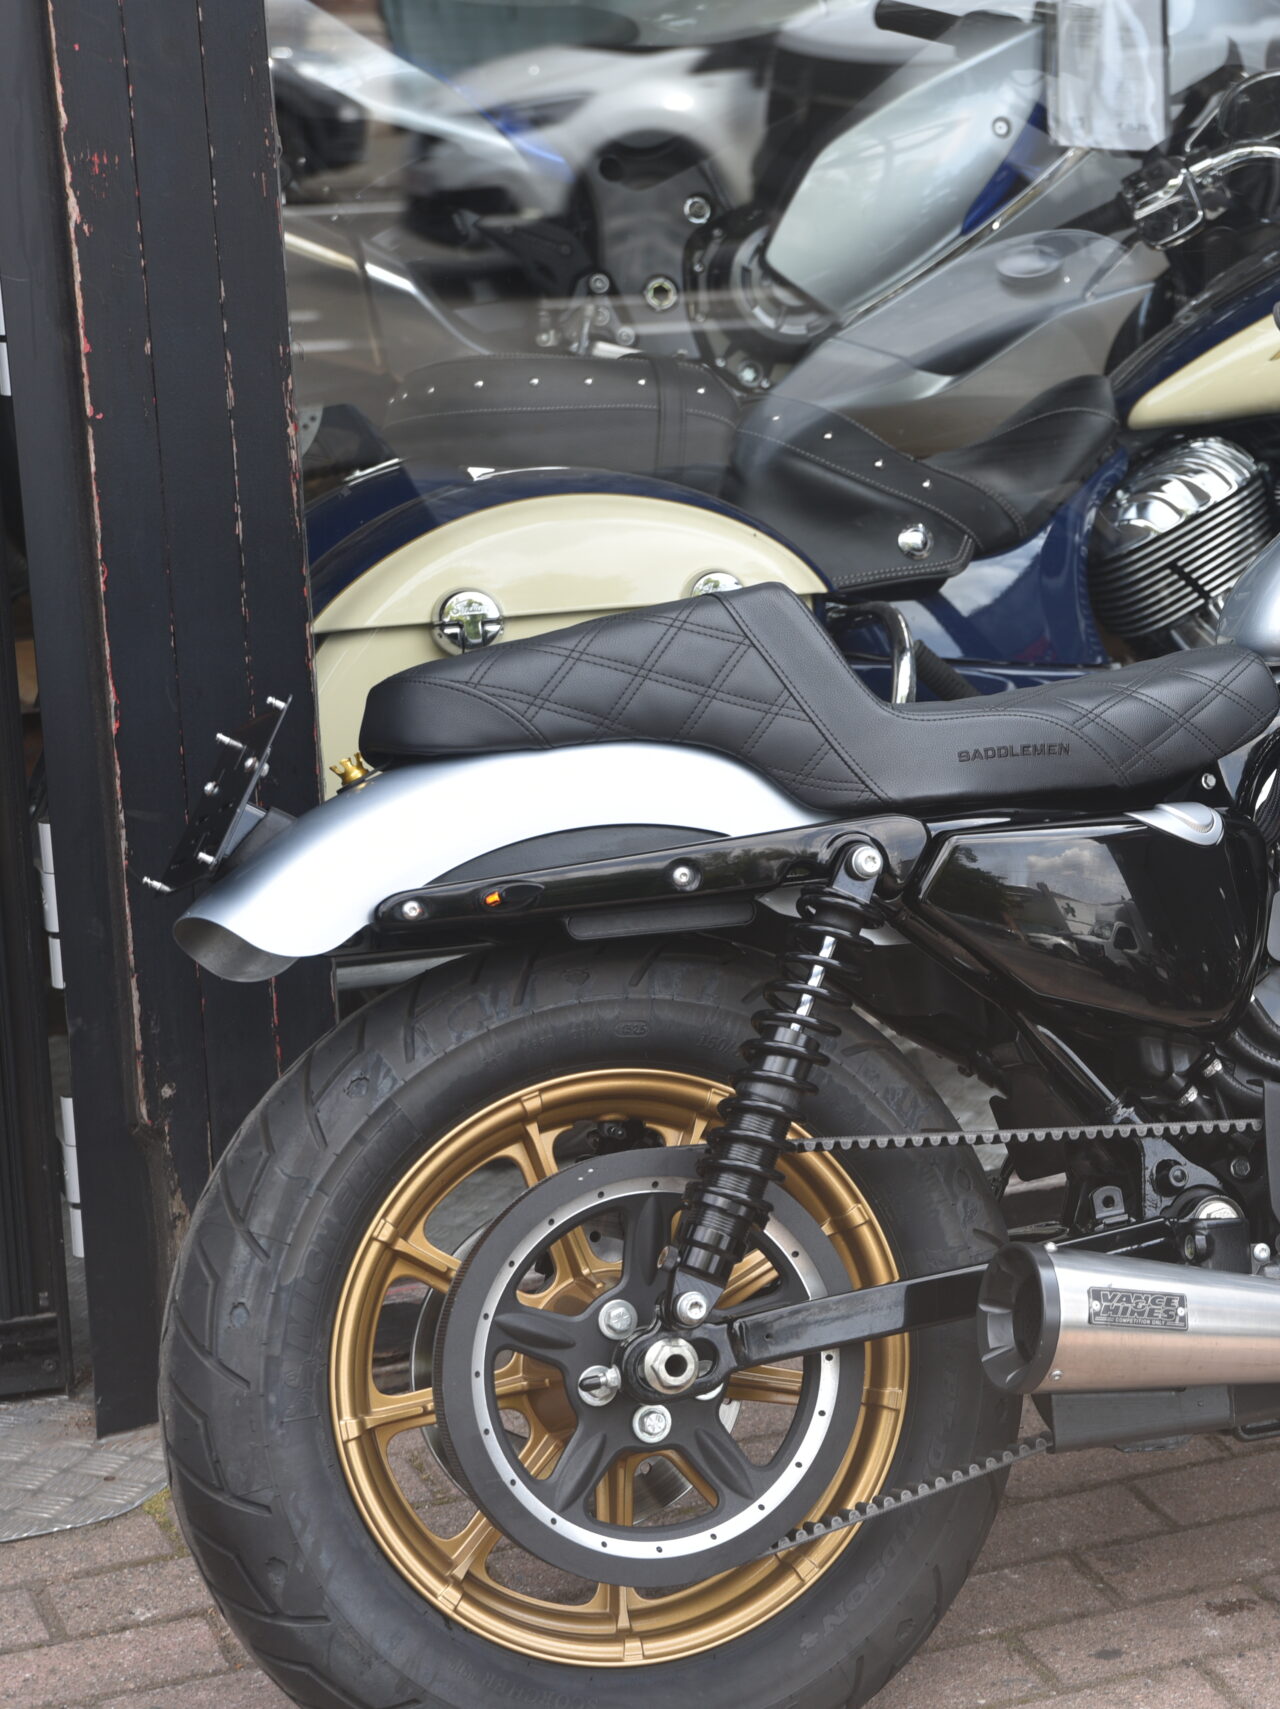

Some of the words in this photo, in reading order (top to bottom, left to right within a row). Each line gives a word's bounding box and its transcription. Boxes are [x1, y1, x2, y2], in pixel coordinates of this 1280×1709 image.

[957, 743, 1070, 763] SADDLEMEN
[1100, 1291, 1180, 1309] VANCE
[1100, 1303, 1177, 1320] HINES
[1115, 1317, 1150, 1325] COMPETITION
